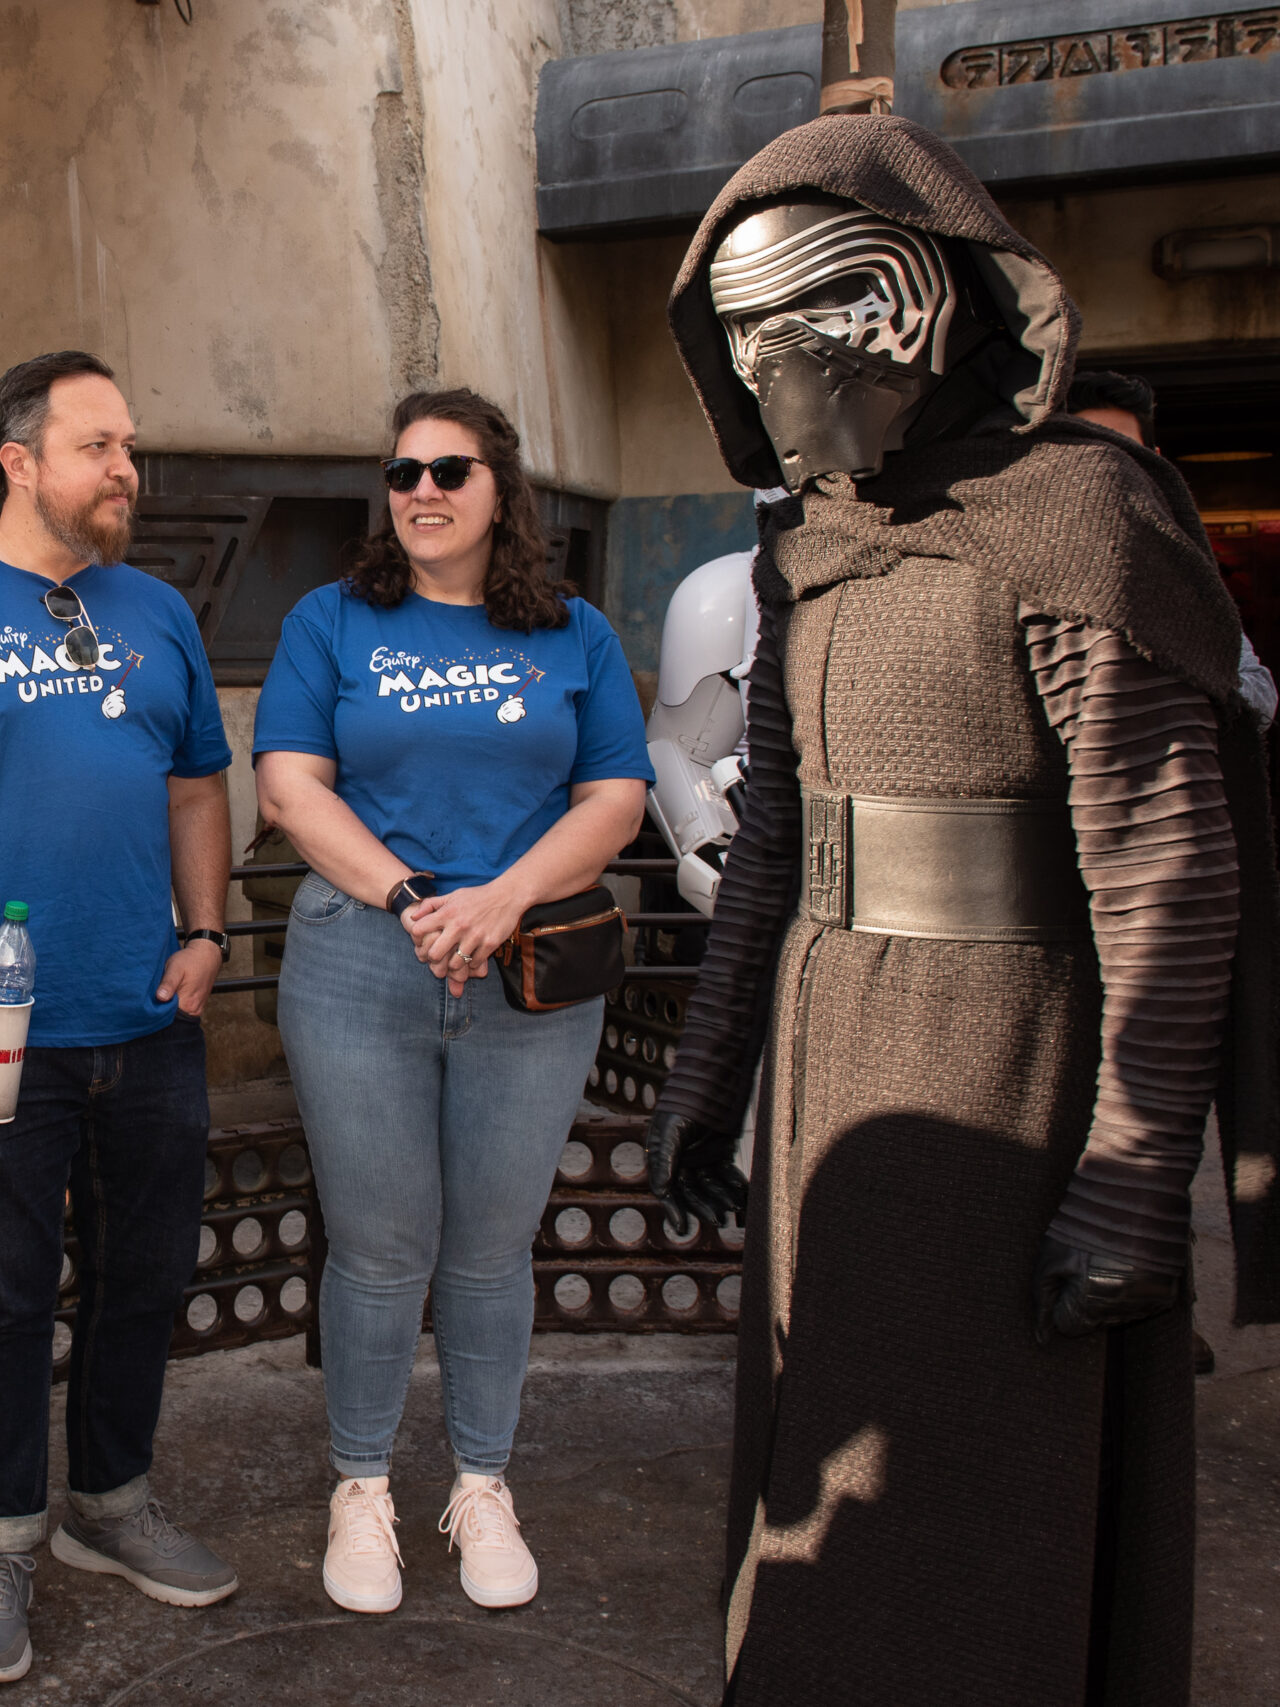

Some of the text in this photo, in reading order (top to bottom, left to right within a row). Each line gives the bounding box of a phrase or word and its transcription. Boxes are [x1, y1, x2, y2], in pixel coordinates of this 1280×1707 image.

[369, 646, 421, 673] Equity
[18, 675, 104, 703] UNITED
[377, 662, 521, 697] MAGIC
[399, 687, 500, 713] UNITED
